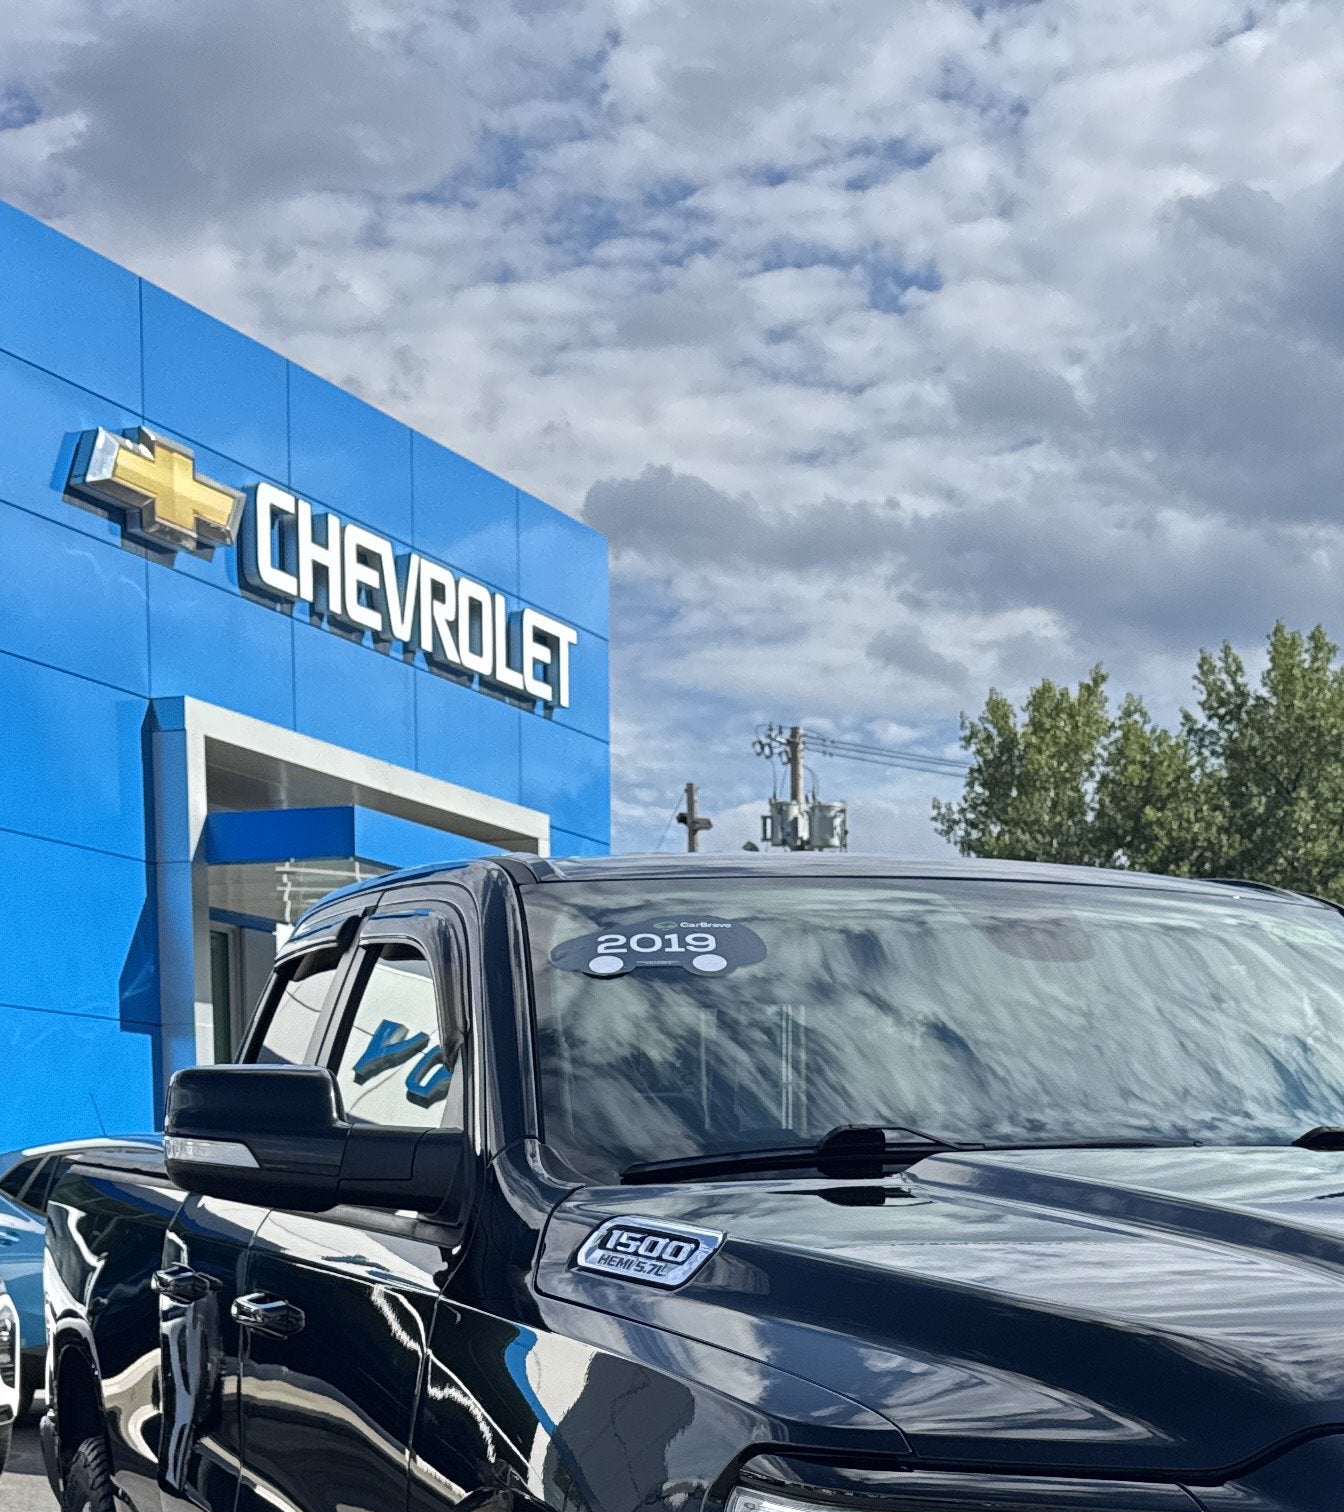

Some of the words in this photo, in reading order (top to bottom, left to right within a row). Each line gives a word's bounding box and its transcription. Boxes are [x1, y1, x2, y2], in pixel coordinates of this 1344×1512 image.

[254, 481, 578, 709] CHEVROLET
[597, 932, 716, 953] 2019
[605, 1229, 696, 1264] 1500
[598, 1252, 635, 1271] HEMI
[634, 1261, 667, 1277] 5.7L
